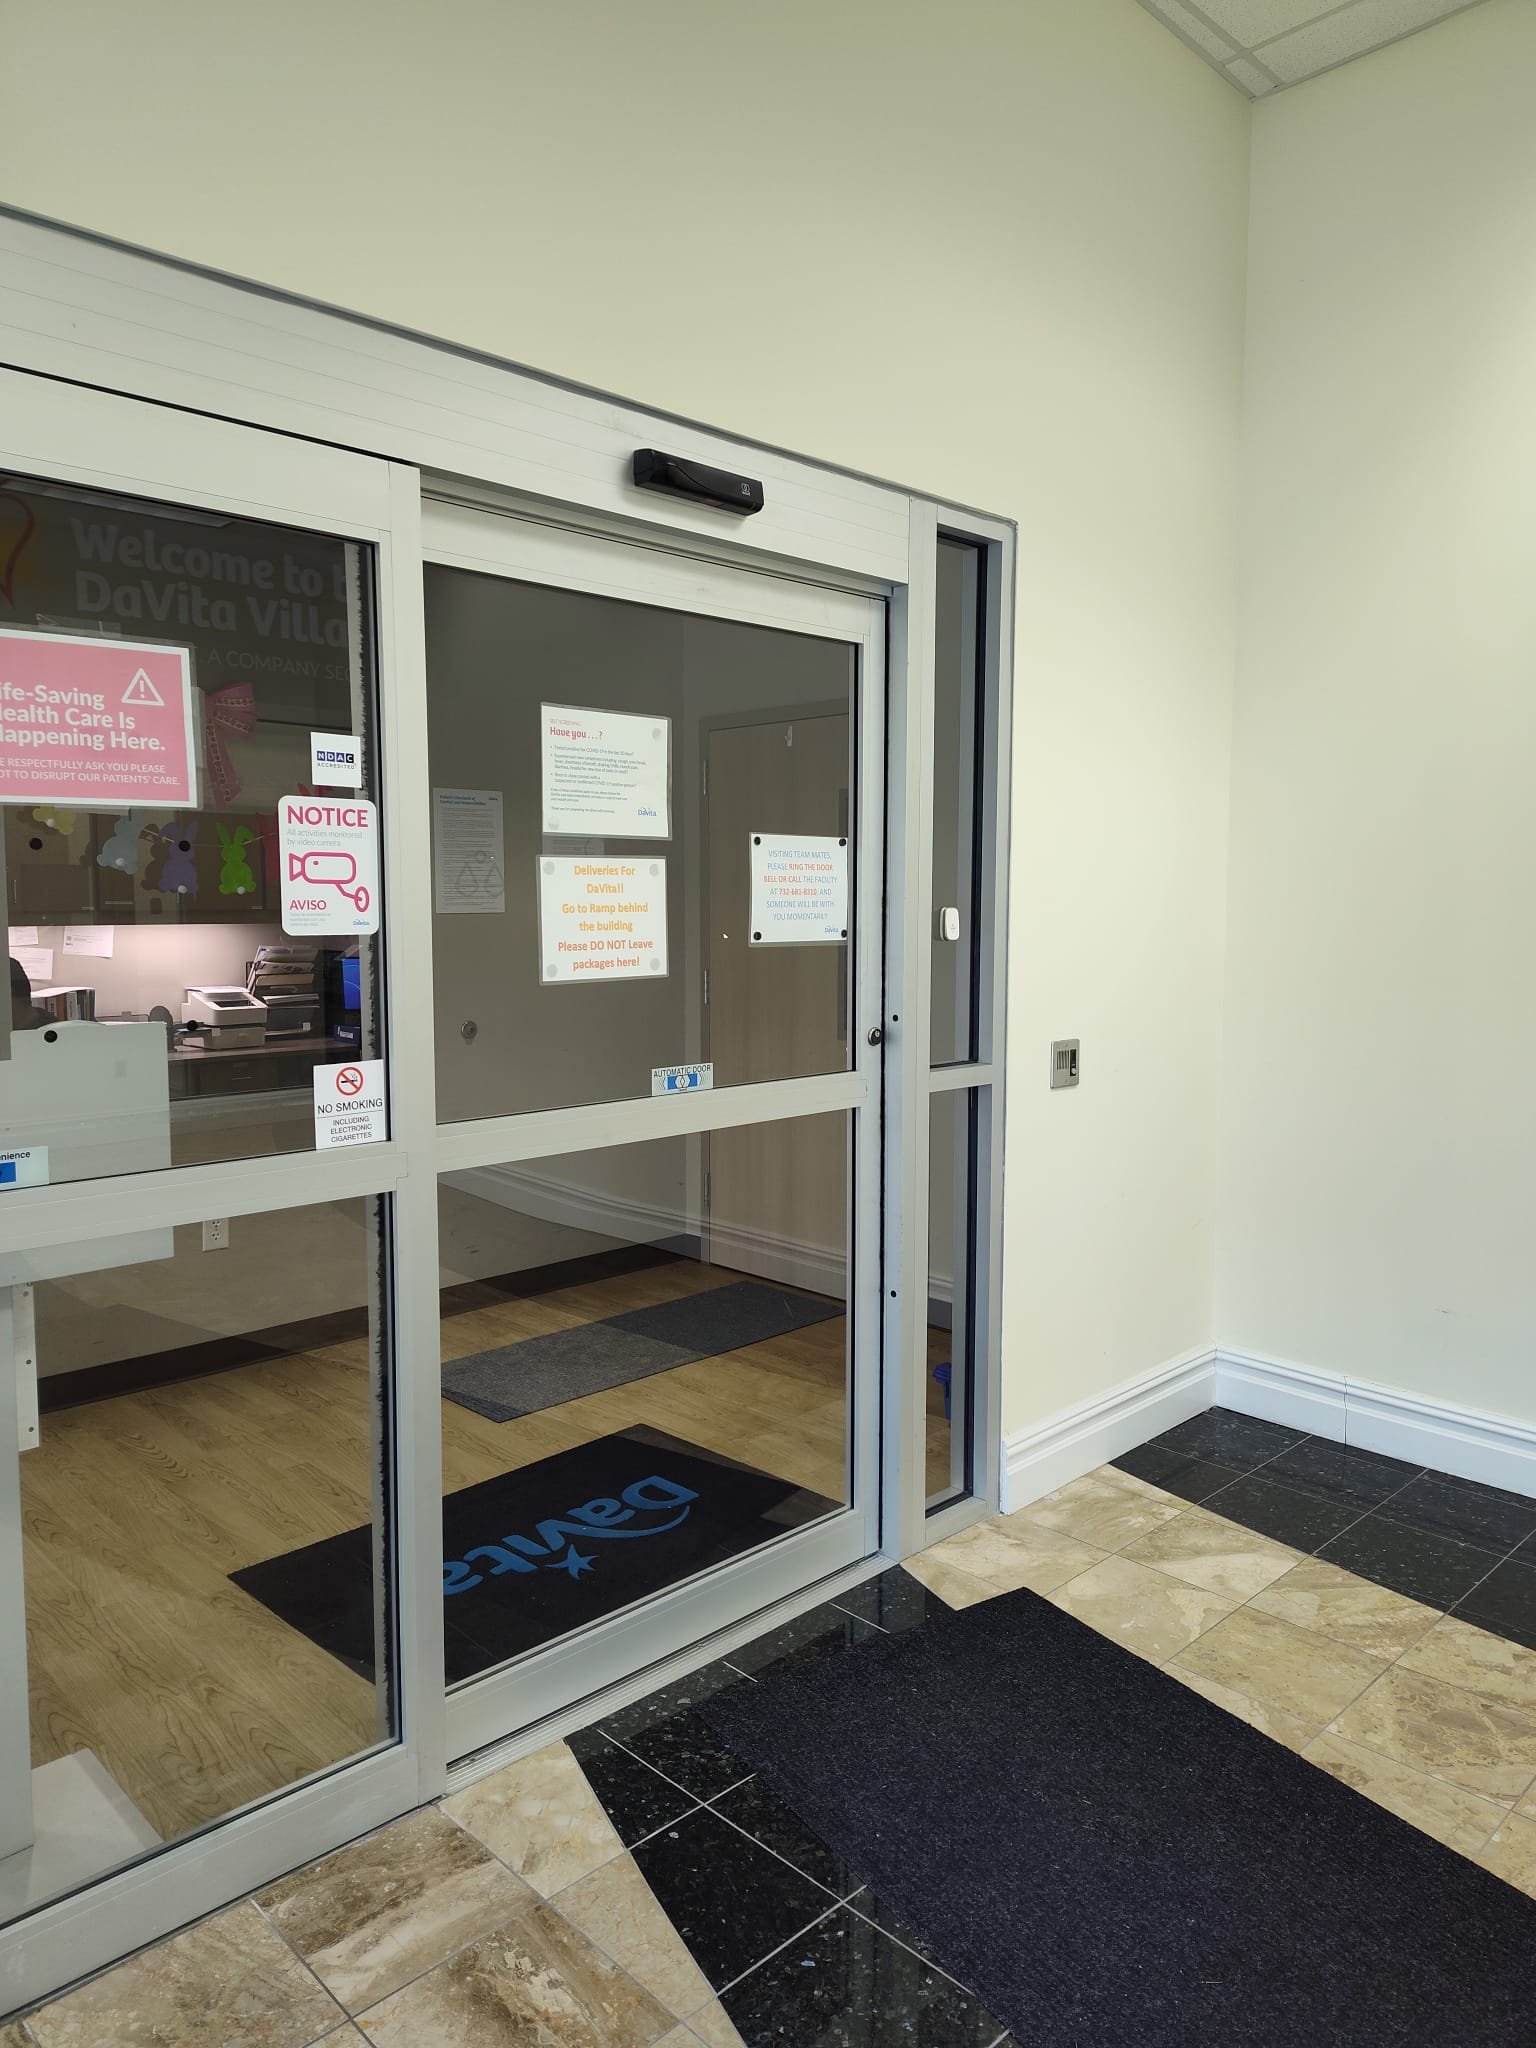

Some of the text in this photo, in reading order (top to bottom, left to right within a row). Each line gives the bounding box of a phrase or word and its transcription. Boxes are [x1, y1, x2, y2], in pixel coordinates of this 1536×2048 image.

[70, 517, 274, 590] Welcome
[283, 554, 323, 597] to
[75, 569, 349, 648] DaVita Villa
[226, 652, 322, 679] COMPANY
[0, 681, 105, 711] ife-Saving
[0, 702, 136, 730] ealth Care Is
[0, 724, 166, 751] appening Here.
[549, 726, 571, 737] Have
[571, 730, 587, 741] you
[317, 752, 354, 763] NDAC
[8, 757, 83, 770] RESPECTFULLY
[85, 761, 105, 771] ASK
[107, 762, 129, 772] YOU
[130, 764, 166, 774] PLEASE
[0, 770, 13, 779] OT
[14, 770, 29, 780] TO
[31, 772, 76, 782] DISRUPT
[78, 773, 100, 783] OUR
[103, 774, 151, 785] PATIENTS'
[287, 805, 368, 828] NOTICE
[328, 830, 363, 840] monitored
[574, 864, 635, 876] Deliveries For
[767, 862, 788, 870] PLEASE
[788, 863, 804, 871] RING
[763, 875, 778, 883] BELL
[778, 875, 787, 883] OR
[788, 875, 802, 883] CALL
[586, 883, 624, 893] DaVita!!
[769, 888, 777, 896] AT
[819, 888, 832, 896] AND
[289, 899, 327, 911] AVISO
[562, 902, 648, 915] Go to Ramp behind
[767, 900, 797, 908] SOMEONE
[773, 912, 786, 920] YOU
[578, 919, 633, 932] the building
[558, 938, 653, 952] Please DO NOT Leave
[573, 956, 640, 972] packages here!
[654, 1064, 711, 1077] AUTOMATIC DOOR
[317, 1097, 383, 1114] NO SMOKING
[332, 1115, 370, 1126] INCLUDING
[330, 1123, 373, 1135] ELECTRONIC
[330, 1131, 372, 1143] CIGARETTES
[0, 1151, 31, 1161] nience
